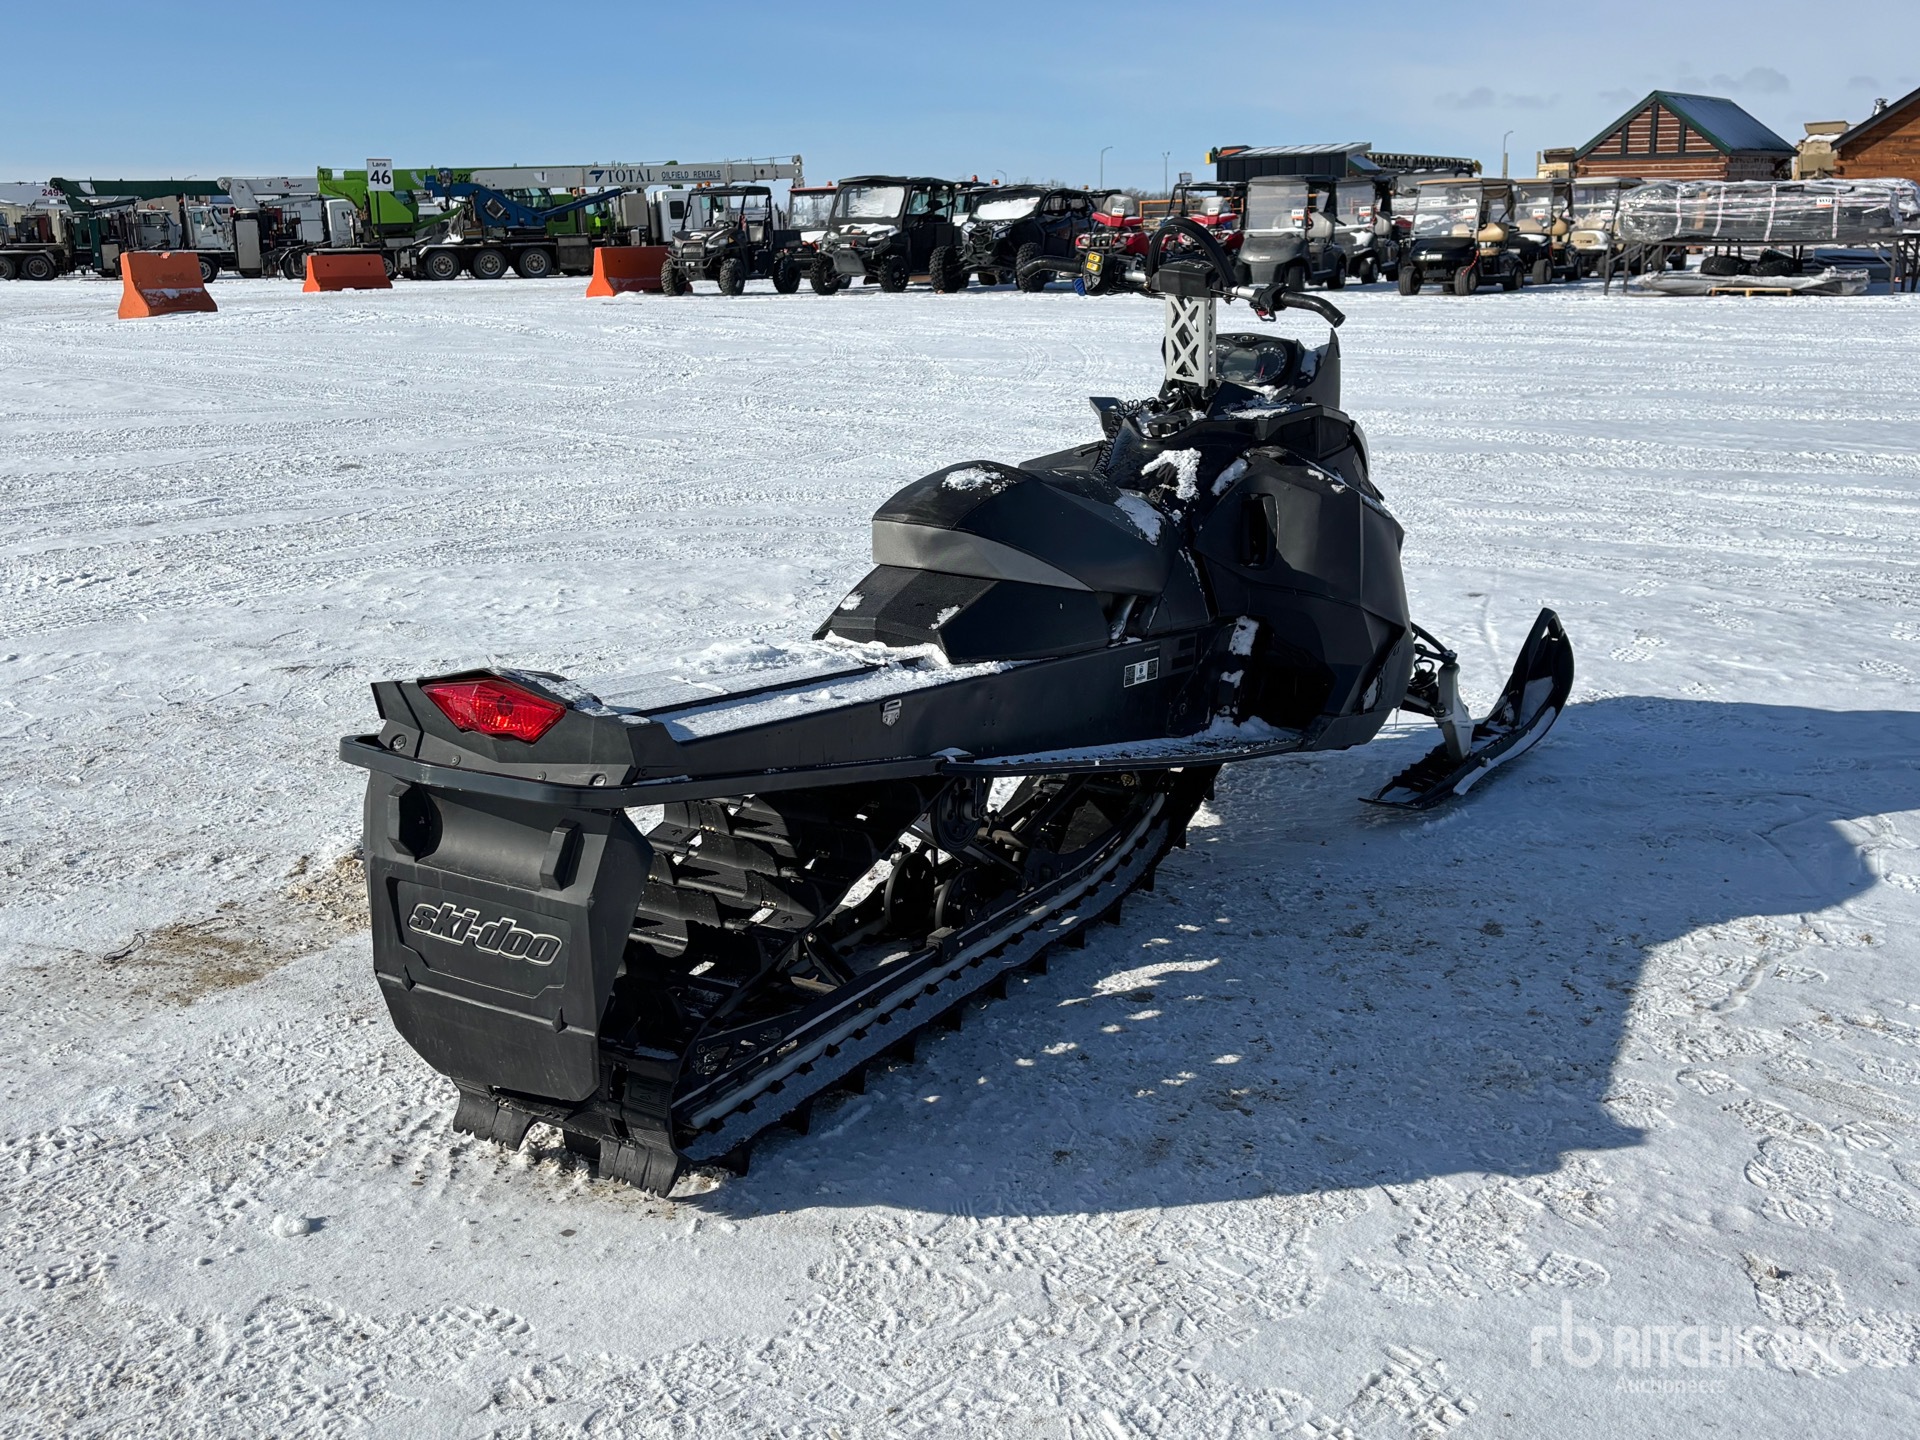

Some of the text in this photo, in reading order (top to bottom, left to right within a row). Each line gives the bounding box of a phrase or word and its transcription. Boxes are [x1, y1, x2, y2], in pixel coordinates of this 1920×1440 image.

[370, 170, 392, 185] 46
[606, 169, 655, 183] TOTAL
[661, 169, 721, 179] OILFIELD RENTALS
